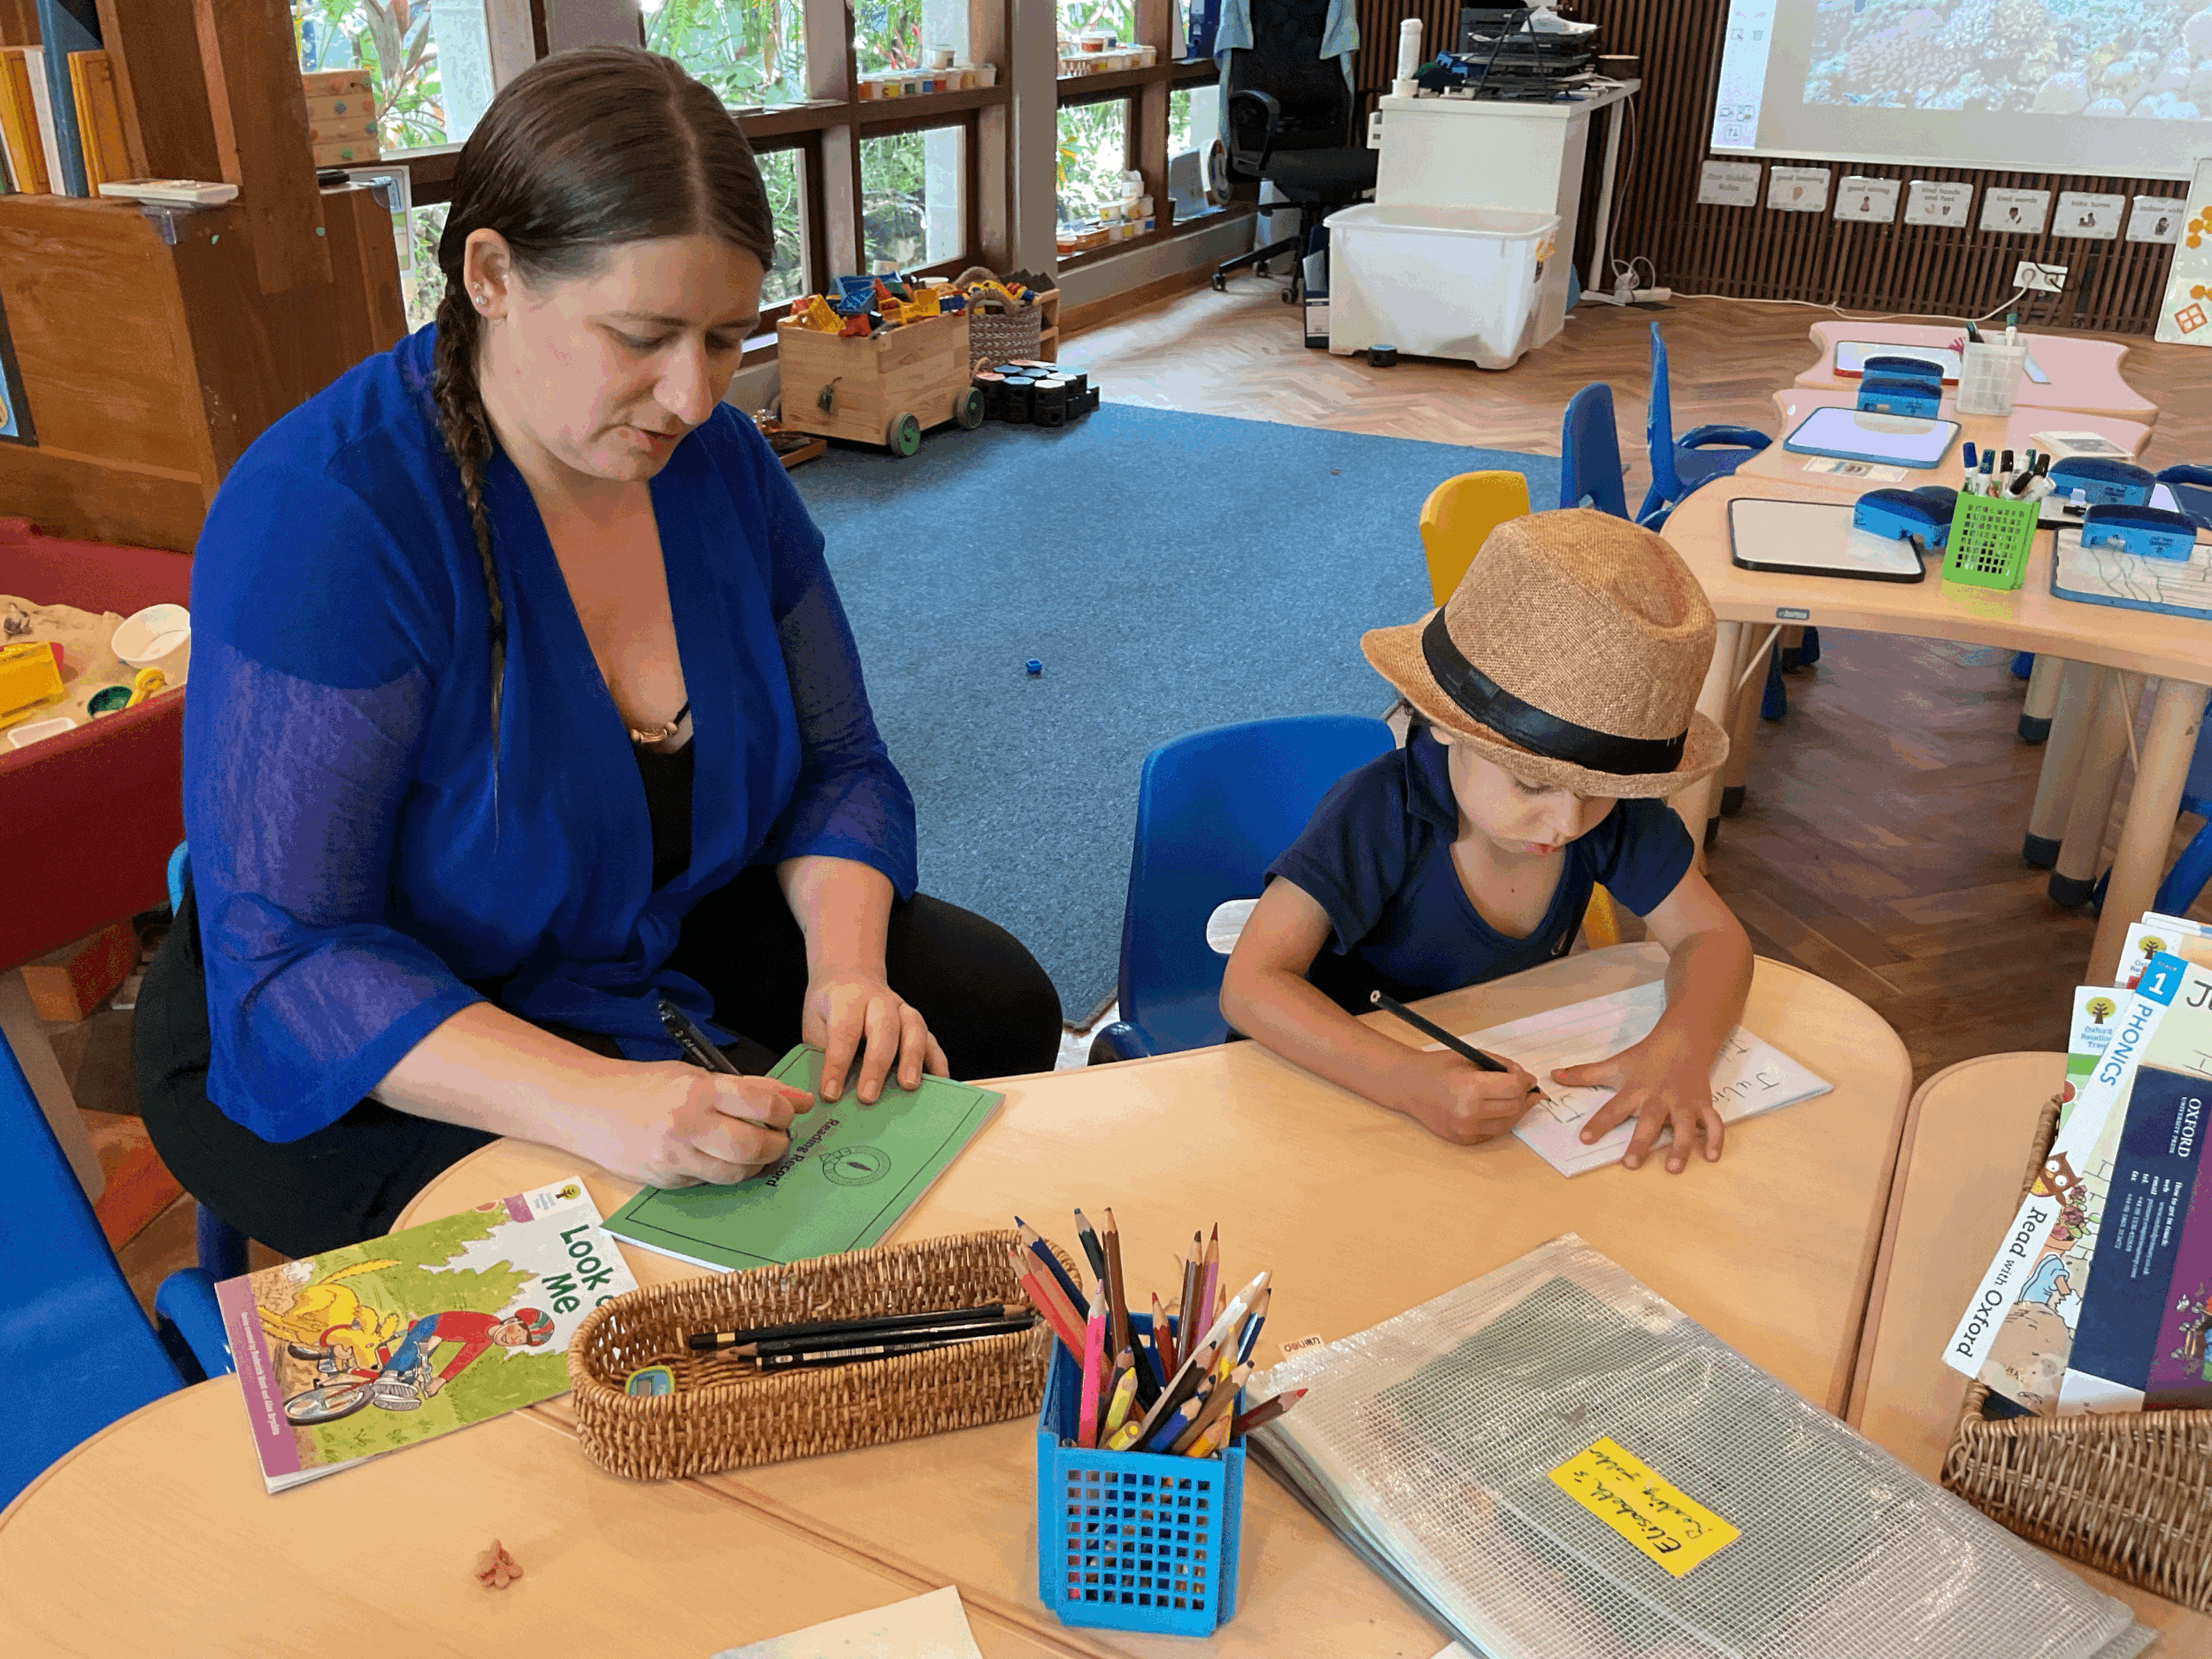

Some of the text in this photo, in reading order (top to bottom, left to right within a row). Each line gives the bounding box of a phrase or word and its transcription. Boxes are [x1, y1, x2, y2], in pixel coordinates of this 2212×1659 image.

[2148, 972, 2167, 995] 1
[2100, 1003, 2154, 1087] PHONICS
[764, 1119, 841, 1187] Reading Record
[2177, 1098, 2202, 1157] OXFORD
[2173, 1181, 2183, 1196] How
[560, 1224, 614, 1291] Look
[1956, 1206, 2048, 1358] Read with Oxford
[541, 1272, 580, 1314] Me
